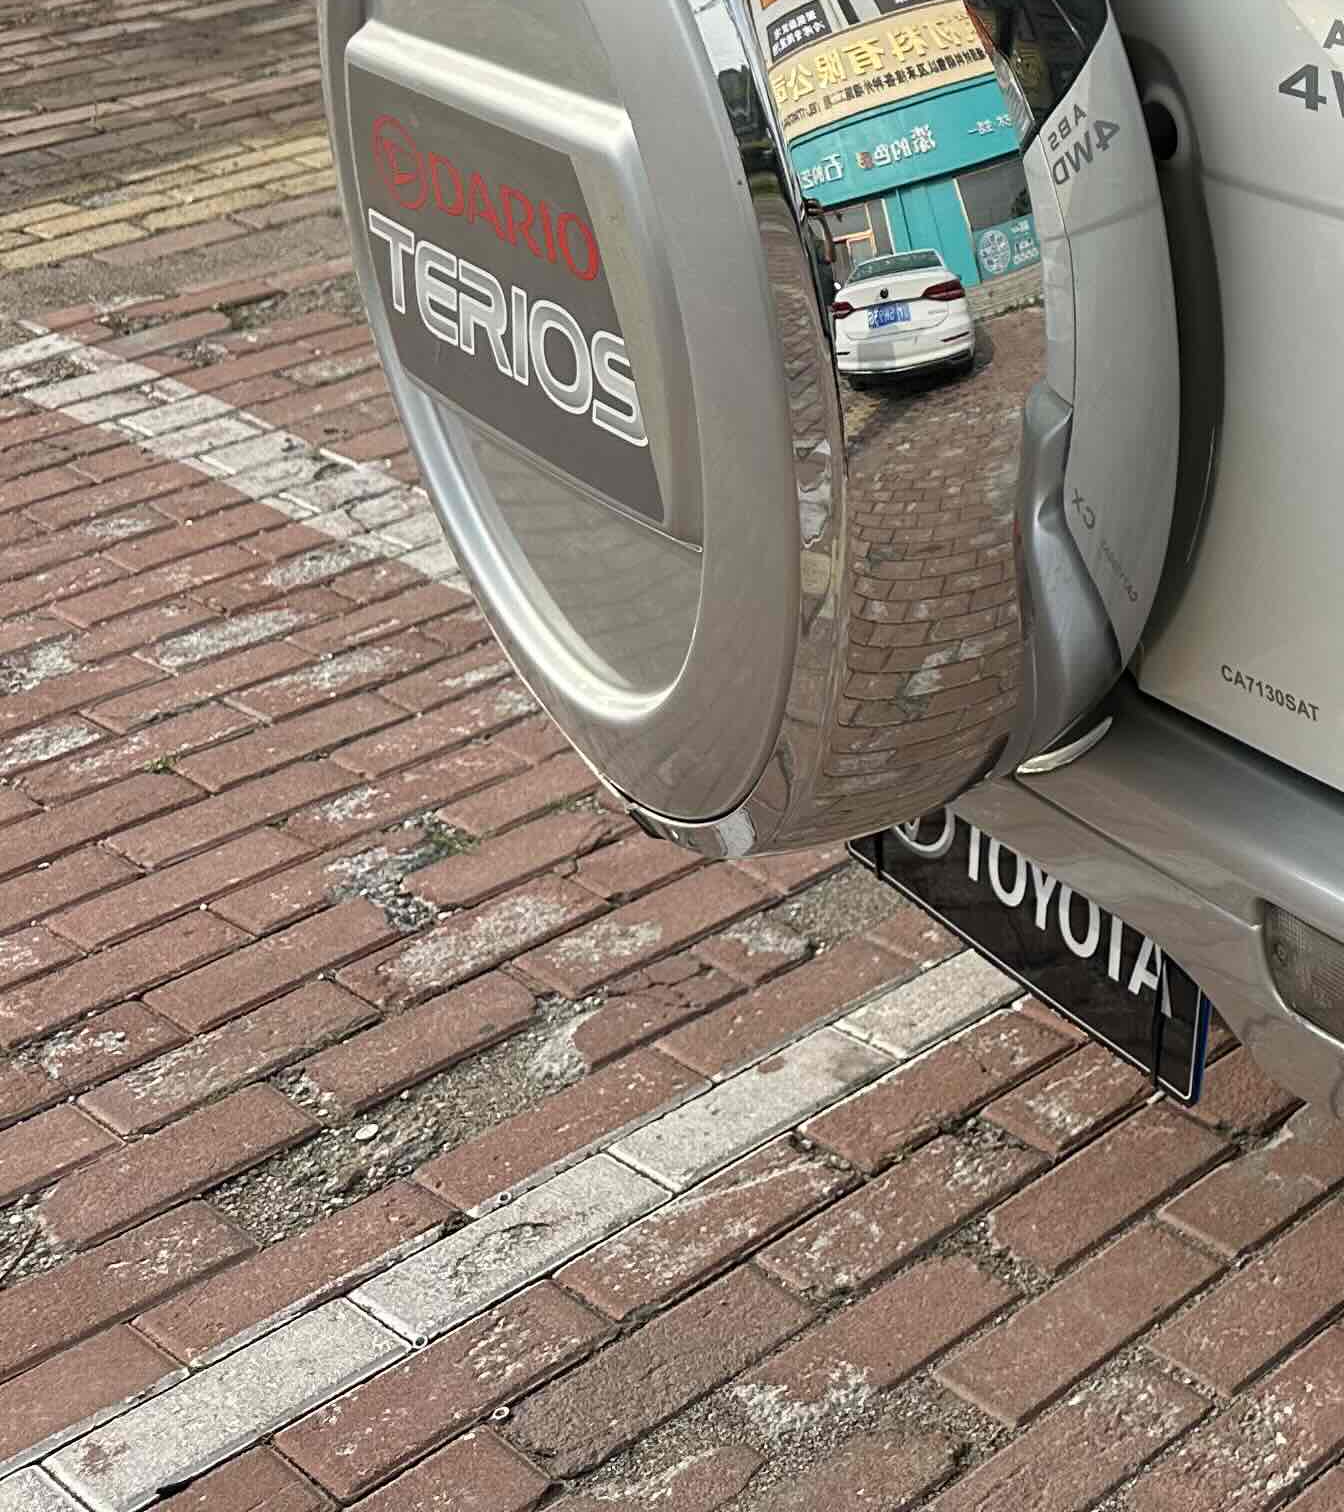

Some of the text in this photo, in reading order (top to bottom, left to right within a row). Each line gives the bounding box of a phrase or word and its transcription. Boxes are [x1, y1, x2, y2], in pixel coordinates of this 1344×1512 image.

[425, 150, 601, 282] DARIO
[368, 208, 649, 448] TERIOS
[1220, 663, 1320, 724] CA7130SAT
